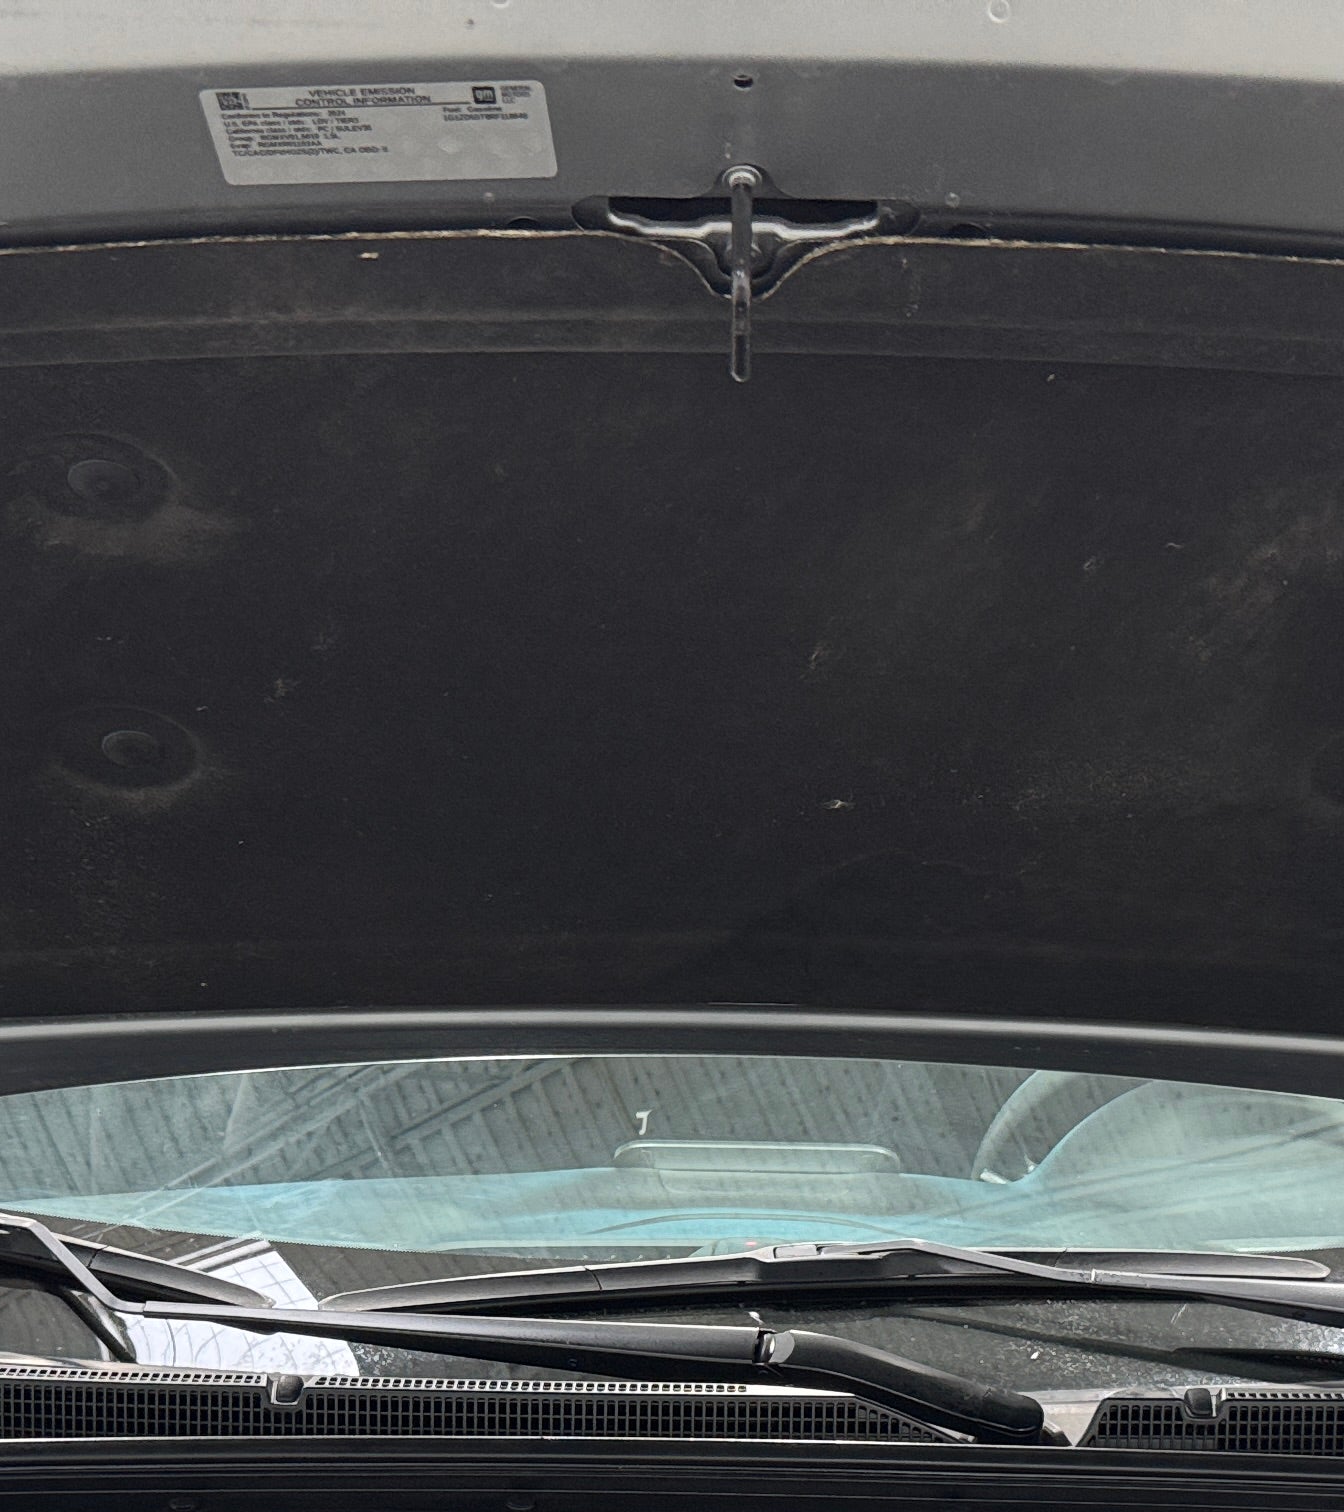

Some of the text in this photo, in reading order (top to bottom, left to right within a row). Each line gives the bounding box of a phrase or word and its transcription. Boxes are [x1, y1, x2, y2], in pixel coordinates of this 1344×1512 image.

[309, 87, 415, 97] VEHICLE EMISSION
[296, 95, 431, 107] CONTROL INFORMATION
